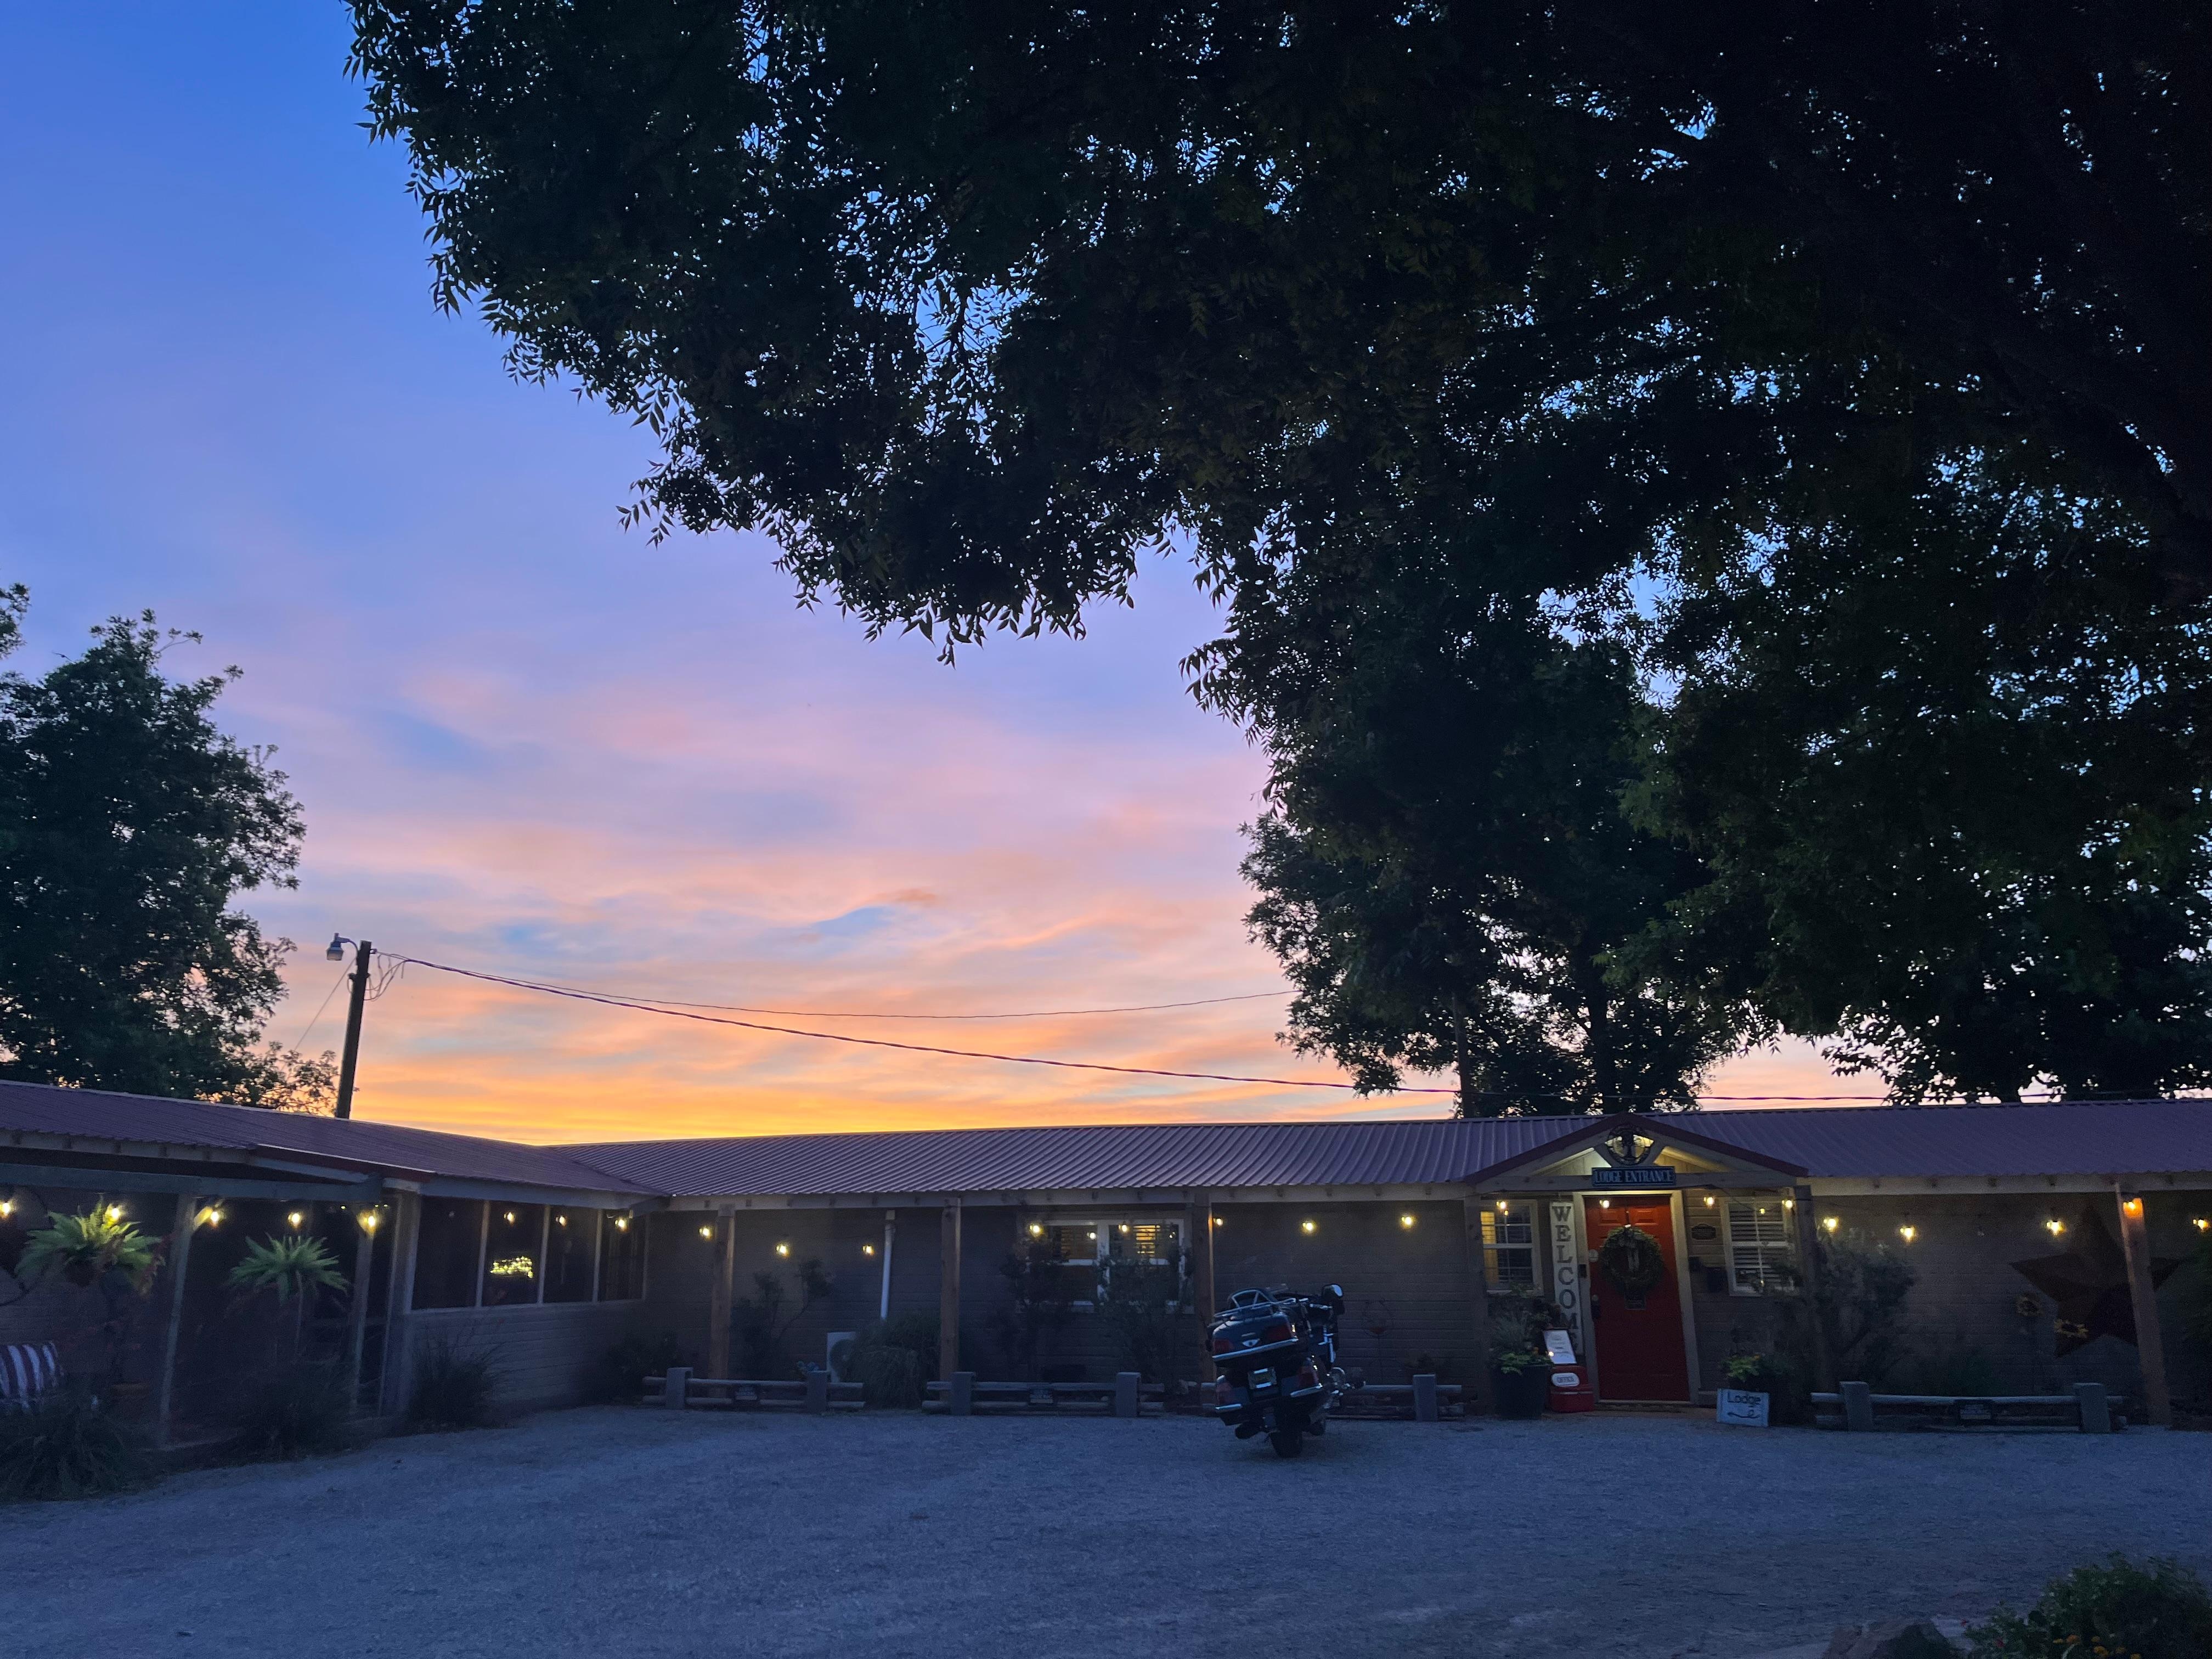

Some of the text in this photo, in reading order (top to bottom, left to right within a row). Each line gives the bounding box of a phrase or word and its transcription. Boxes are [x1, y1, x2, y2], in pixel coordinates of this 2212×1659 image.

[1625, 1170, 1673, 1182] ENTRANCE
[1551, 1206, 1578, 1347] WELCOM
[1728, 1391, 1760, 1408] Lodge
